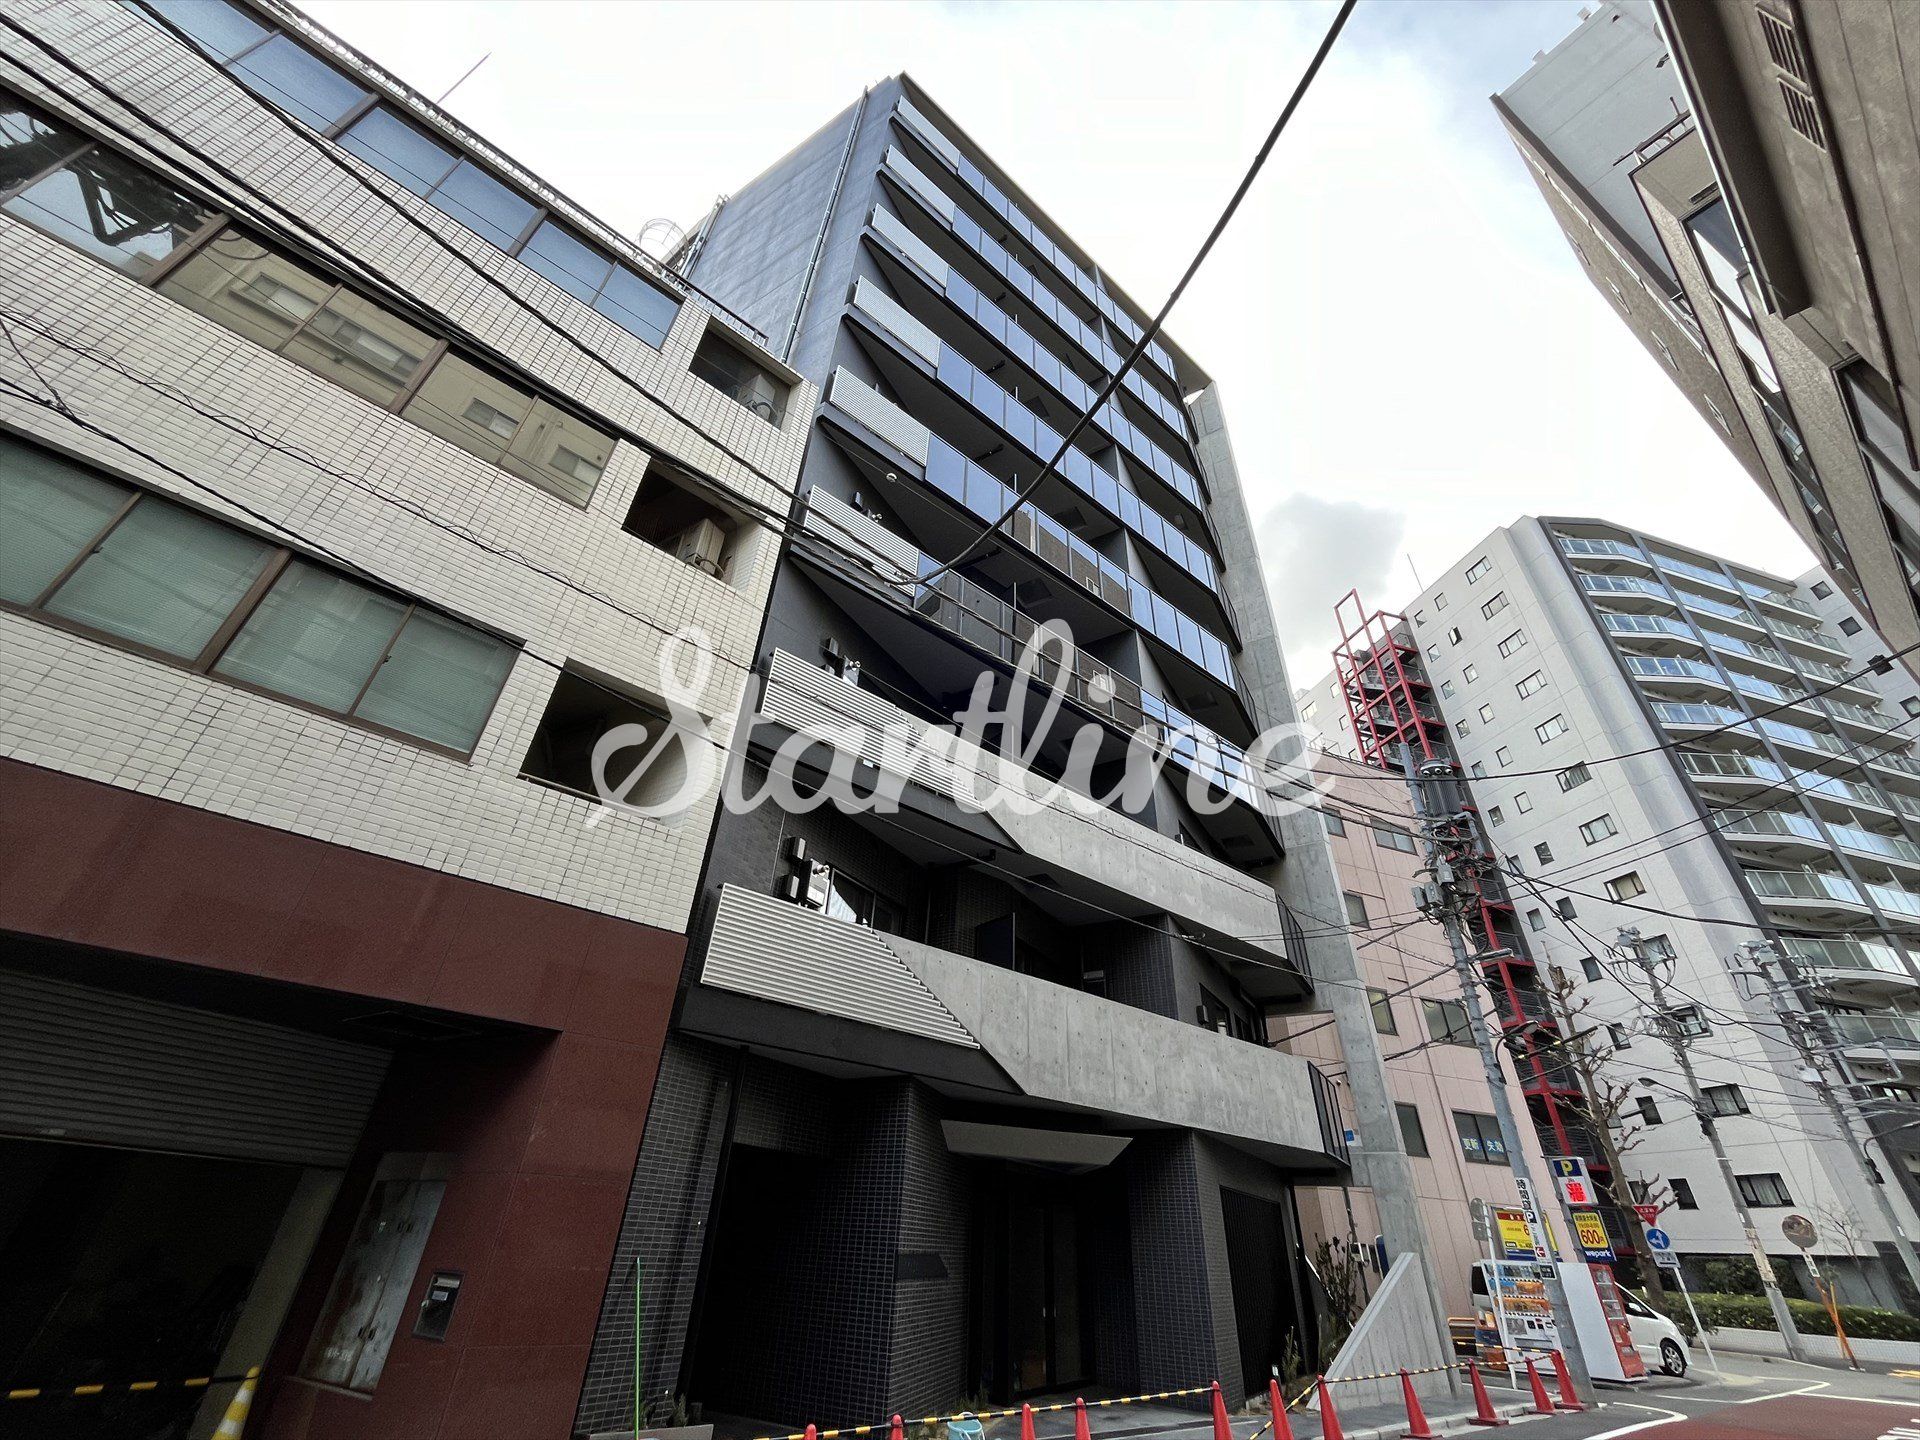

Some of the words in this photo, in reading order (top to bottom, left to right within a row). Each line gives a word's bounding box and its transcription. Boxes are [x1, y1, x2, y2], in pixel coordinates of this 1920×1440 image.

[1462, 1137, 1480, 1151] 更新
[1560, 1160, 1573, 1176] P
[1525, 1211, 1535, 1224] P
